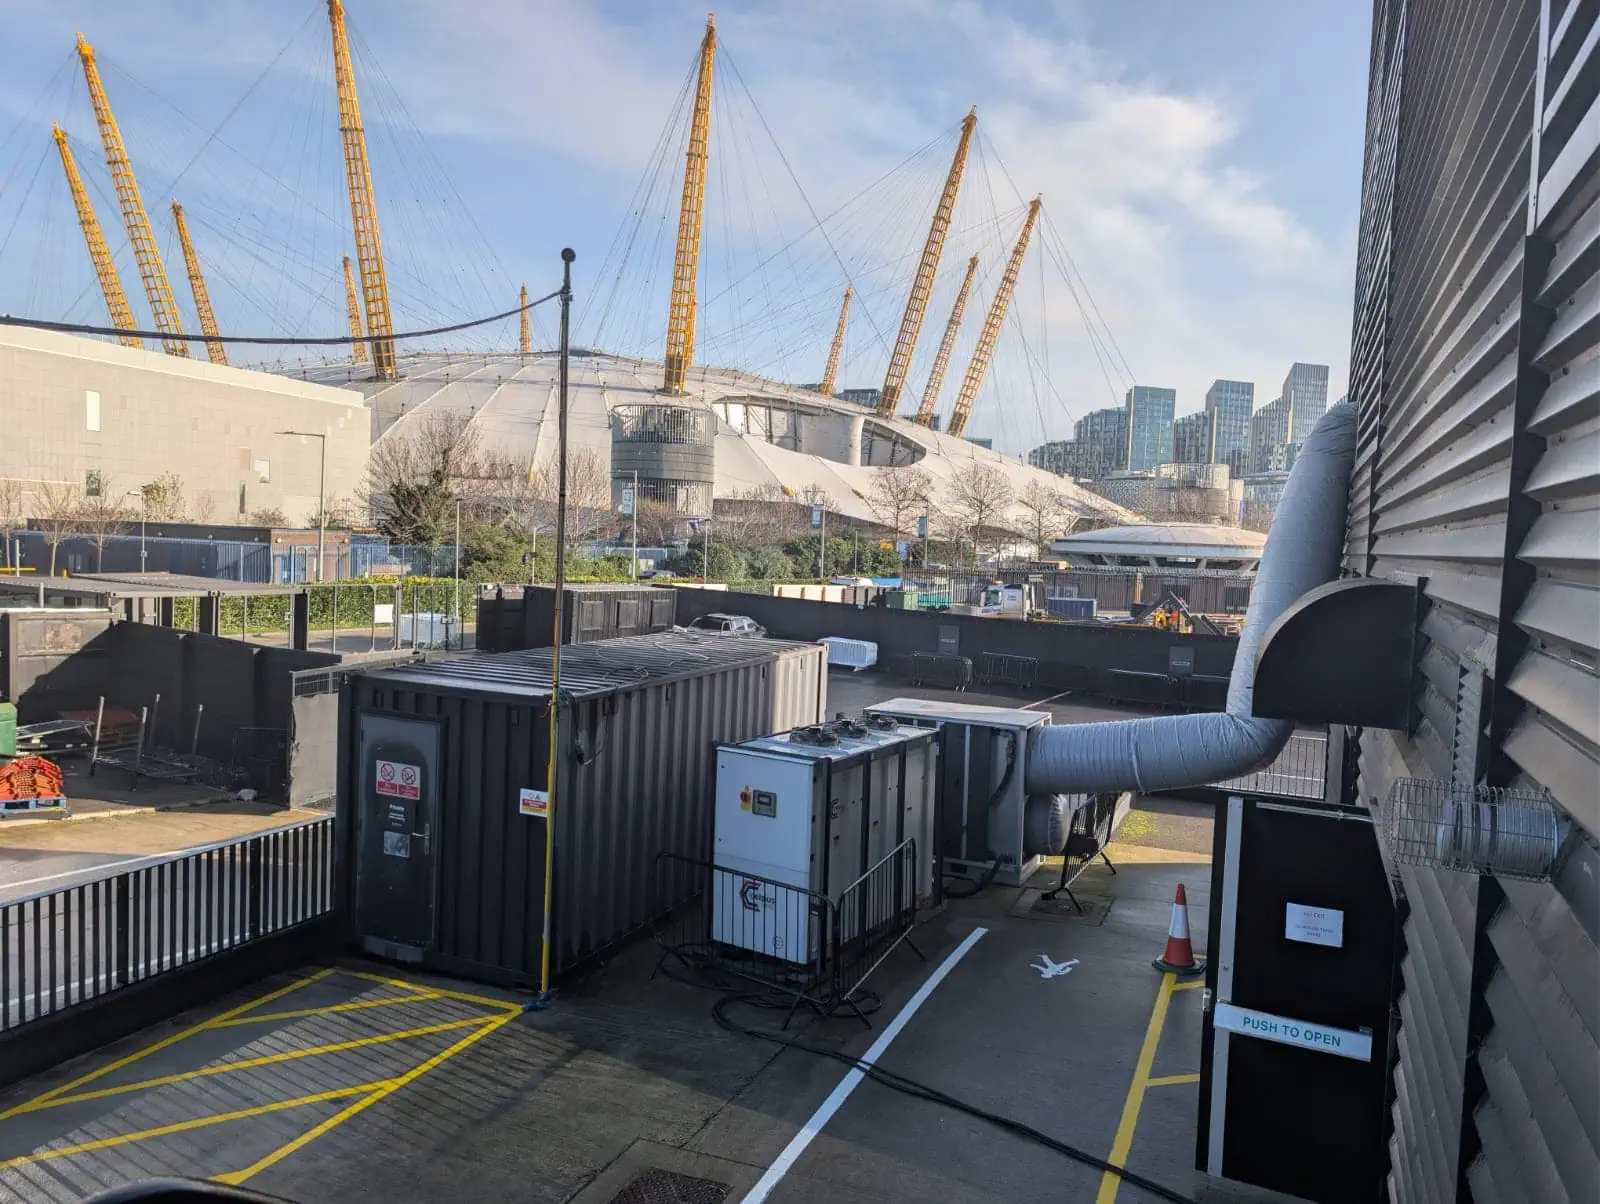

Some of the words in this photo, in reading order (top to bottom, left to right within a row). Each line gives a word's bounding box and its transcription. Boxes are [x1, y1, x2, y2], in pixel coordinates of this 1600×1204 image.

[1243, 1016, 1278, 1033] PUSH
[1282, 1025, 1300, 1038] TO
[1303, 1030, 1341, 1046] OPEN
